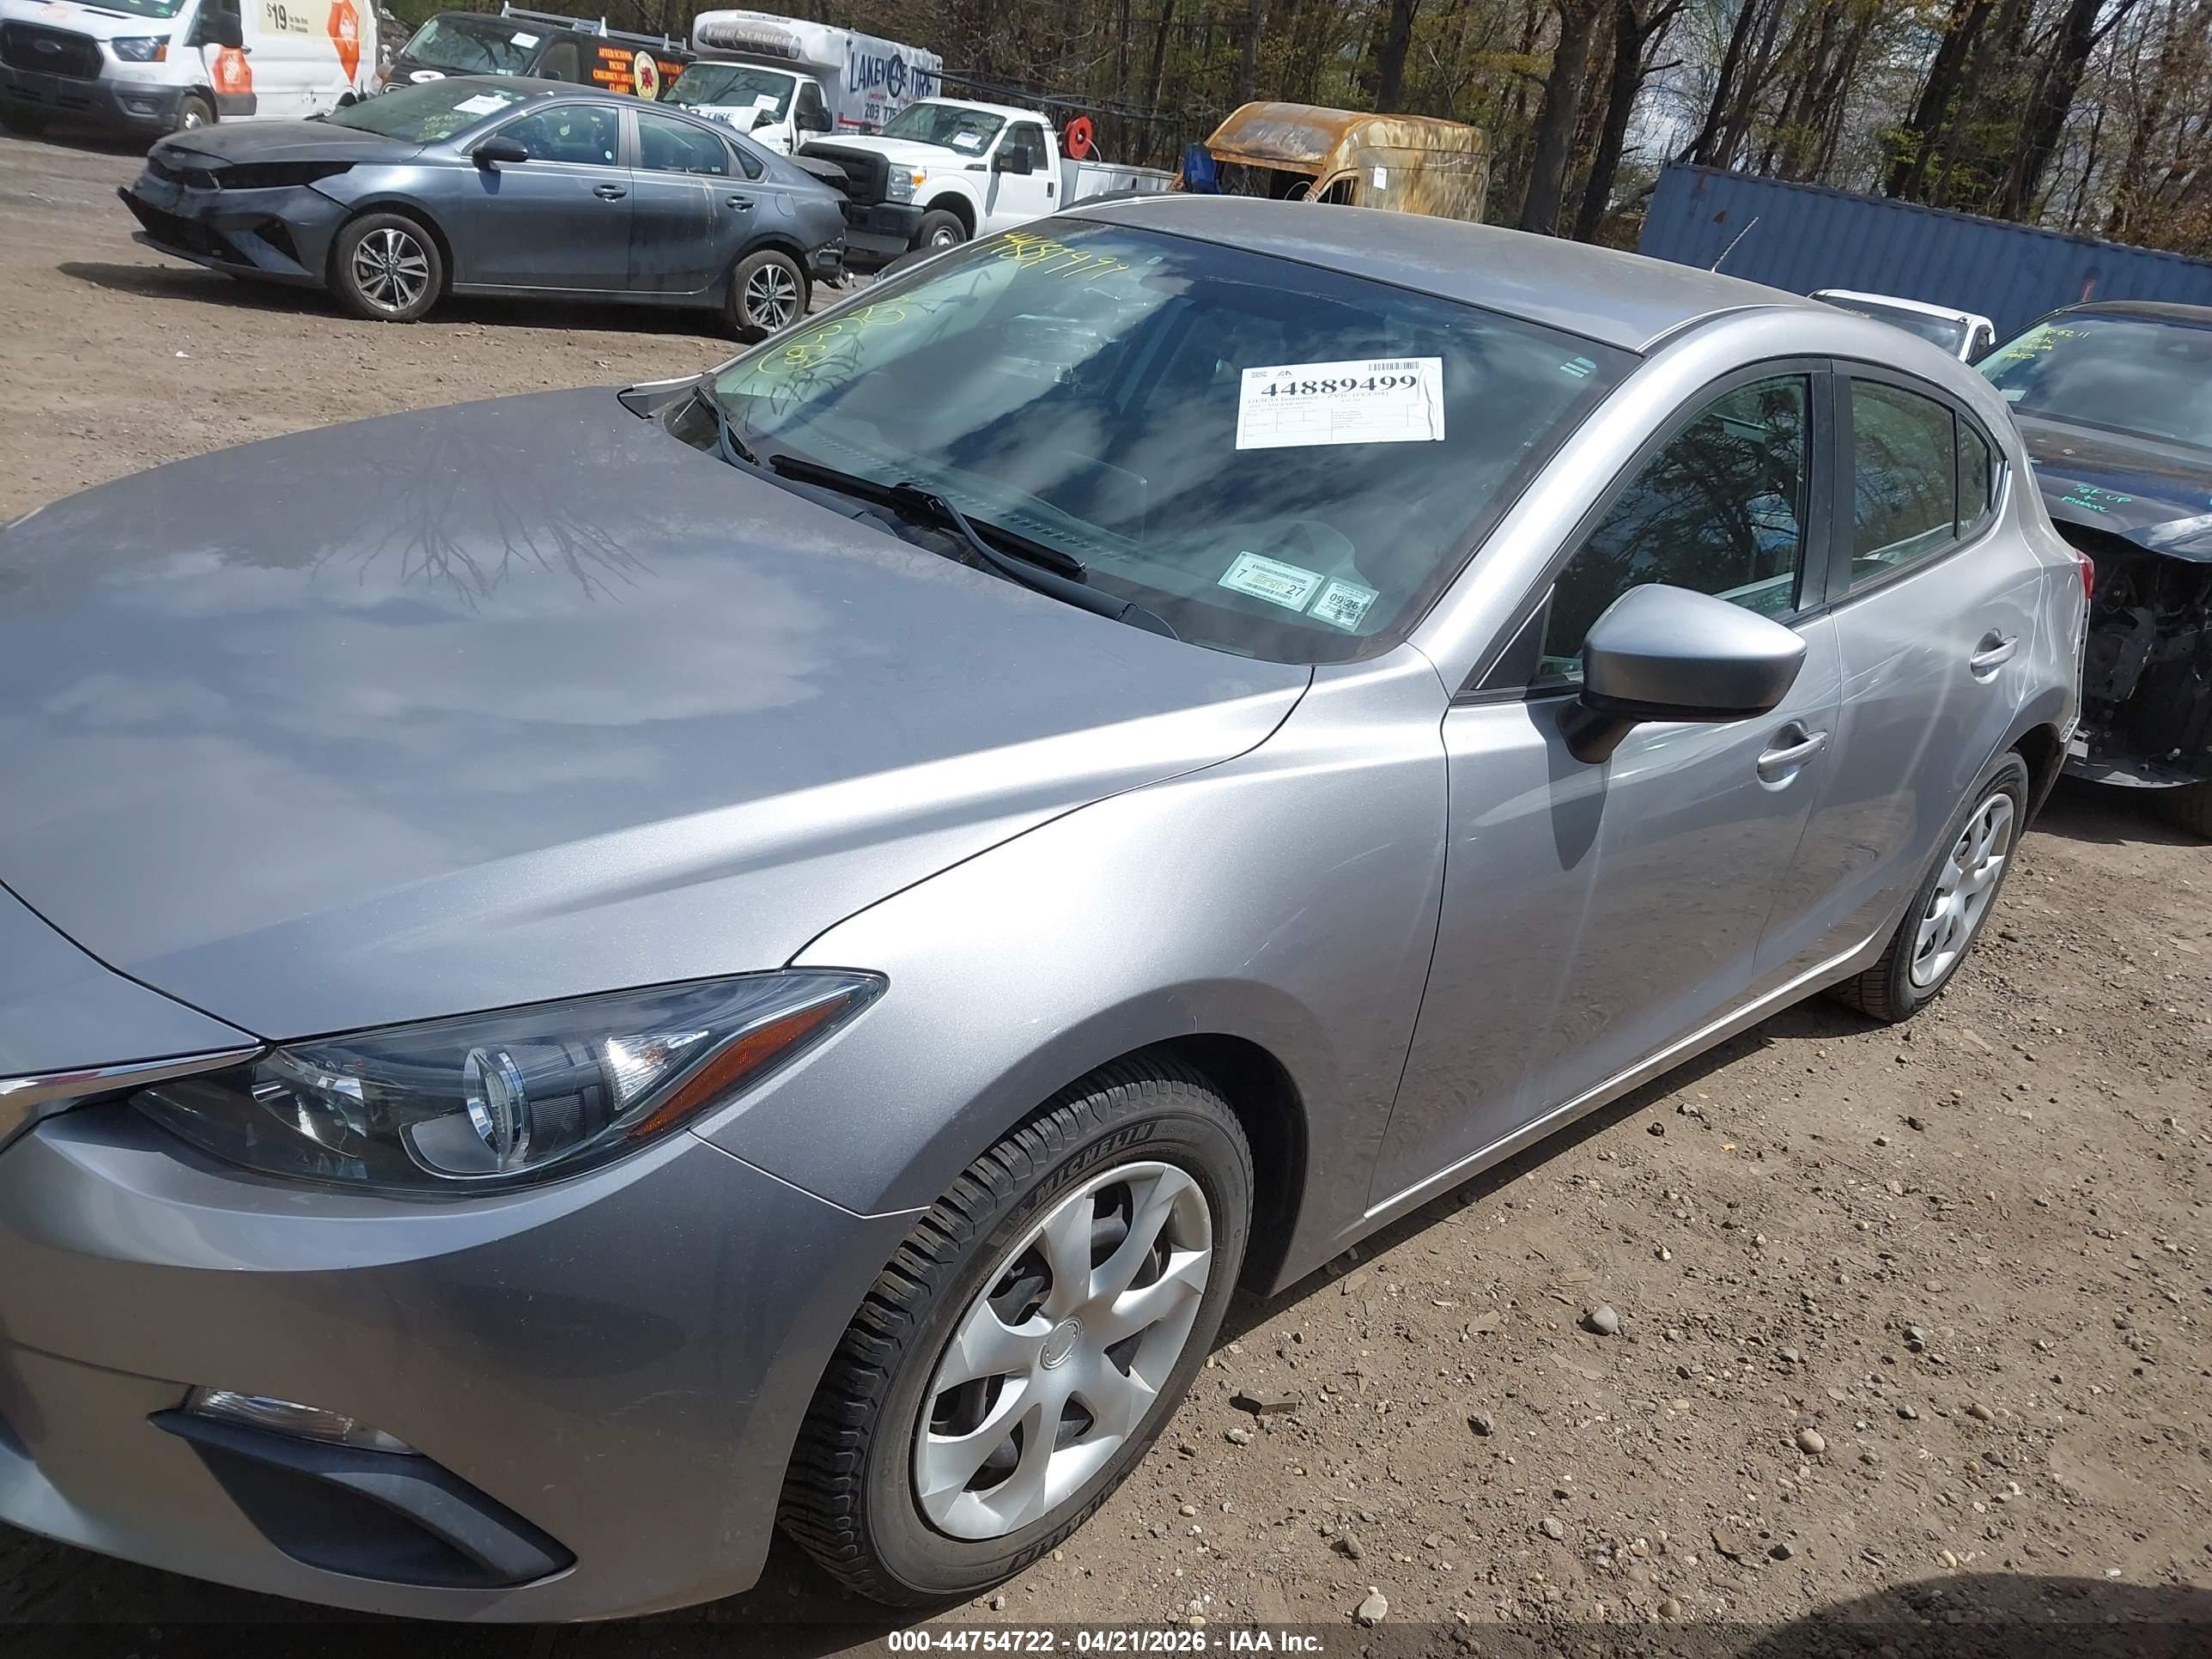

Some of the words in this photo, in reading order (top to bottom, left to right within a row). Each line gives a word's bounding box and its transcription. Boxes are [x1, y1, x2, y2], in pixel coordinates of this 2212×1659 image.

[266, 3, 287, 30] $19
[1261, 374, 1418, 397] 44889499
[1237, 568, 1248, 578] 7
[1285, 584, 1305, 597] 27
[1035, 1121, 1158, 1201] MICHELIN
